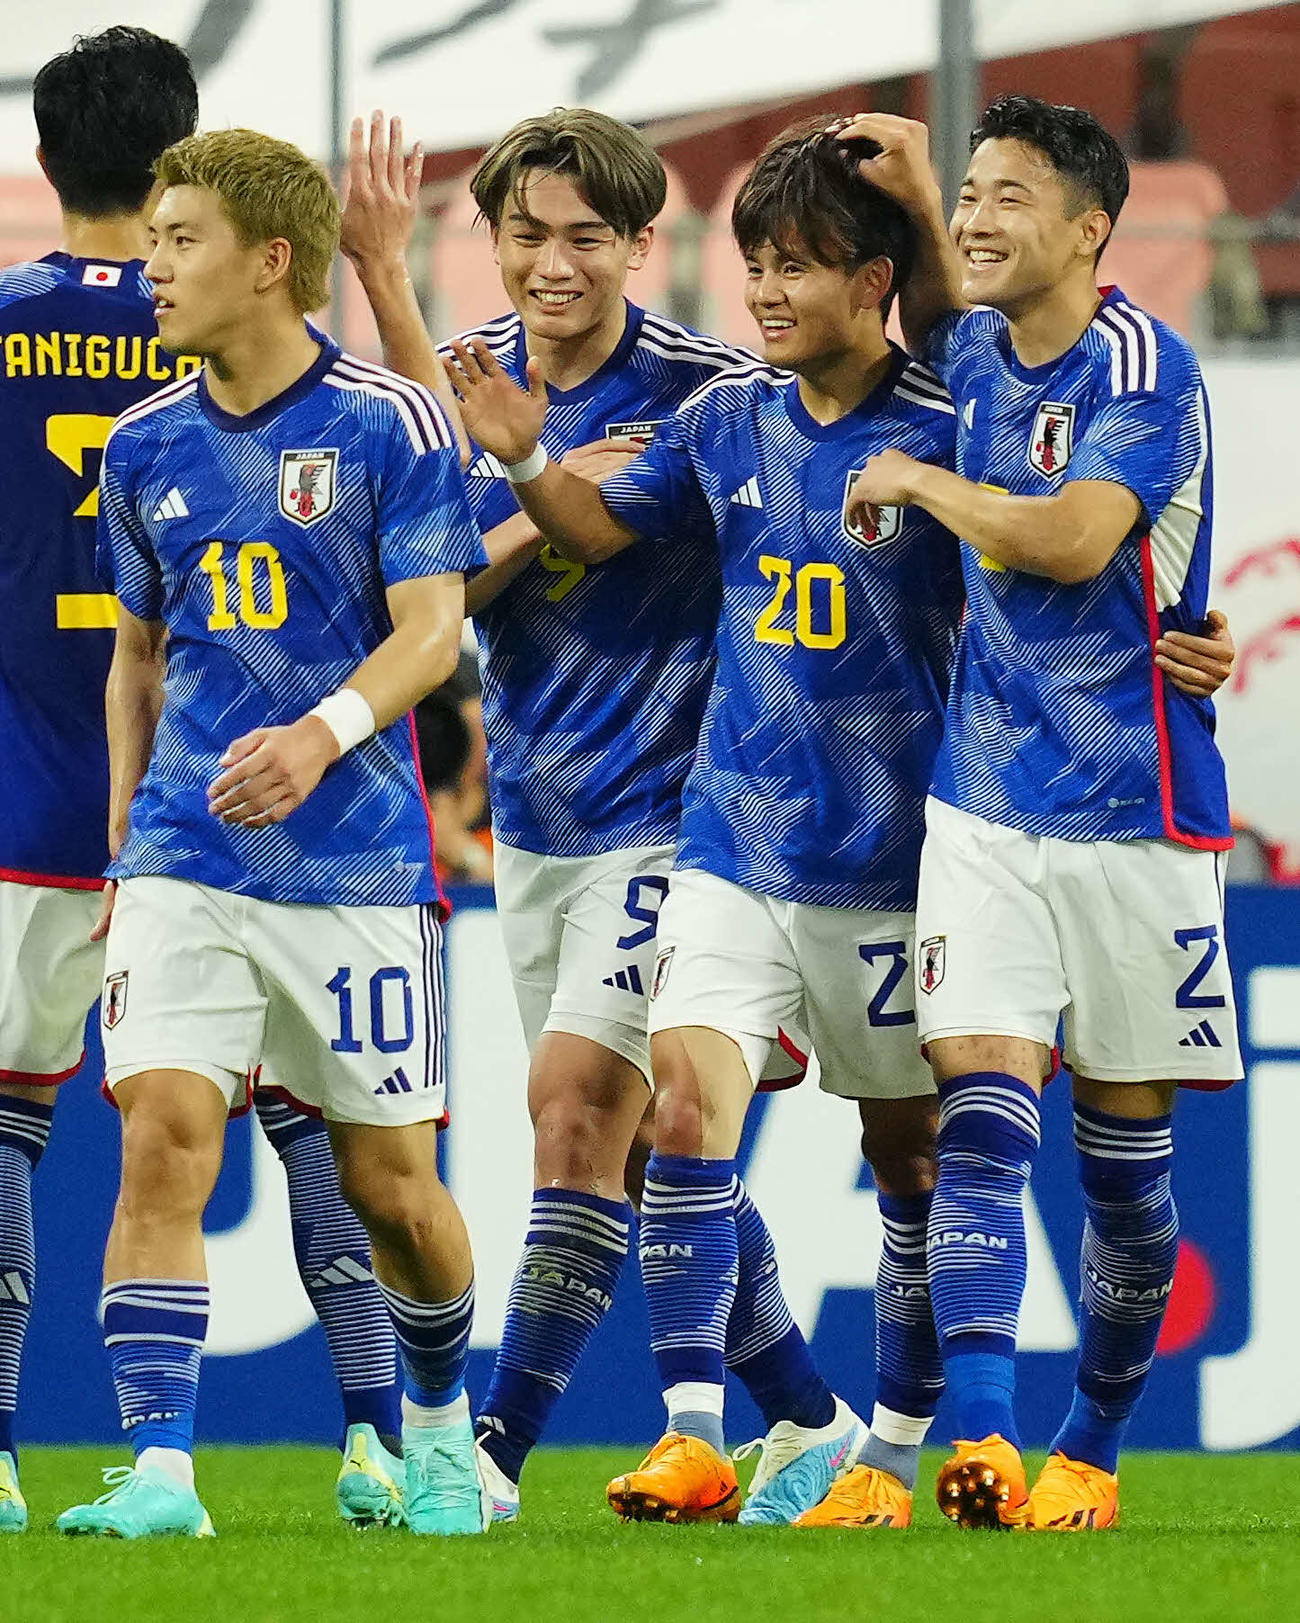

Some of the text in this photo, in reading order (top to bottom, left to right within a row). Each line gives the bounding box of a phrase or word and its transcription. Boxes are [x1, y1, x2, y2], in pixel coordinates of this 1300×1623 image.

[0, 331, 201, 381] ANIGUC
[620, 425, 652, 434] JAPAN
[198, 541, 289, 631] 10
[754, 554, 847, 650] 20
[615, 875, 671, 951] 9
[858, 940, 917, 1028] 2
[1174, 924, 1226, 1009] 2
[325, 965, 415, 1053] 10
[521, 1266, 614, 1312] JAPAN
[1086, 1269, 1174, 1302] JAPAN
